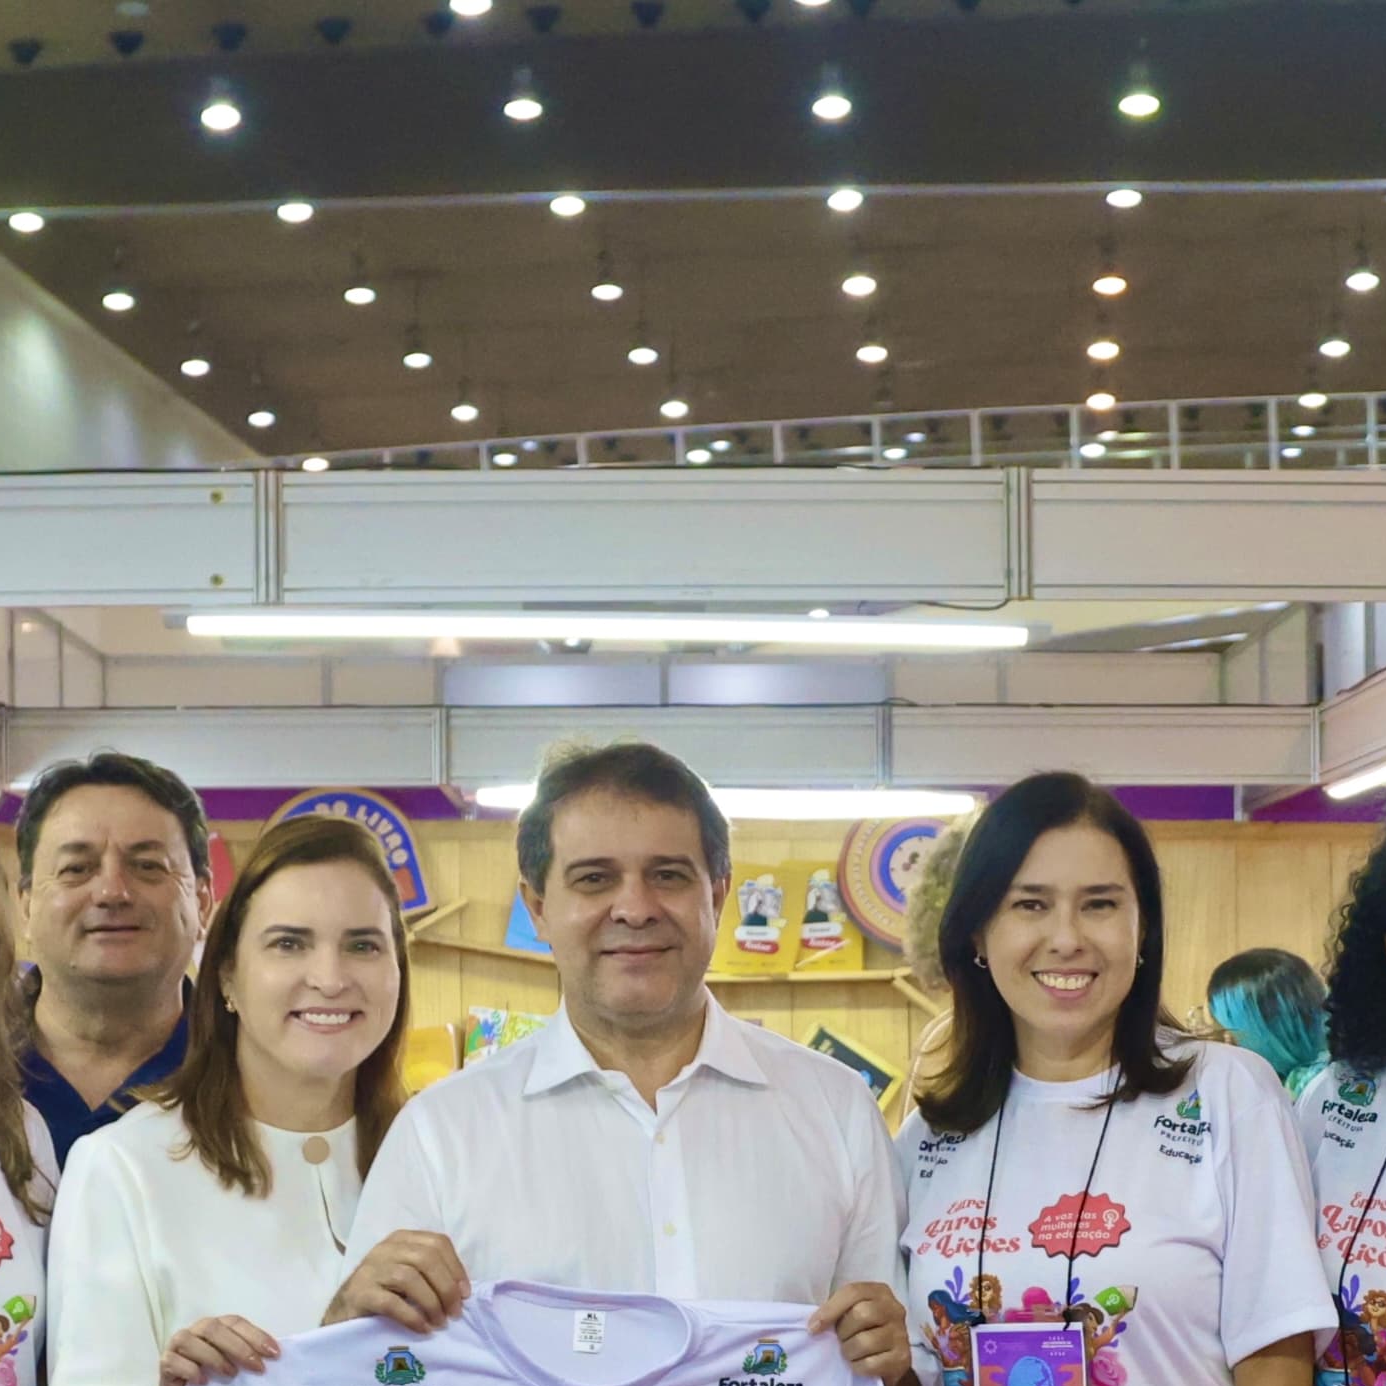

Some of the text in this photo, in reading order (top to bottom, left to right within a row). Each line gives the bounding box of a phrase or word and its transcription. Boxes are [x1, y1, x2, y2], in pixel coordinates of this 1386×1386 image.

[356, 805, 409, 865] LIVRO
[1055, 1212, 1073, 1221] voz
[936, 1234, 1020, 1259] Lições
